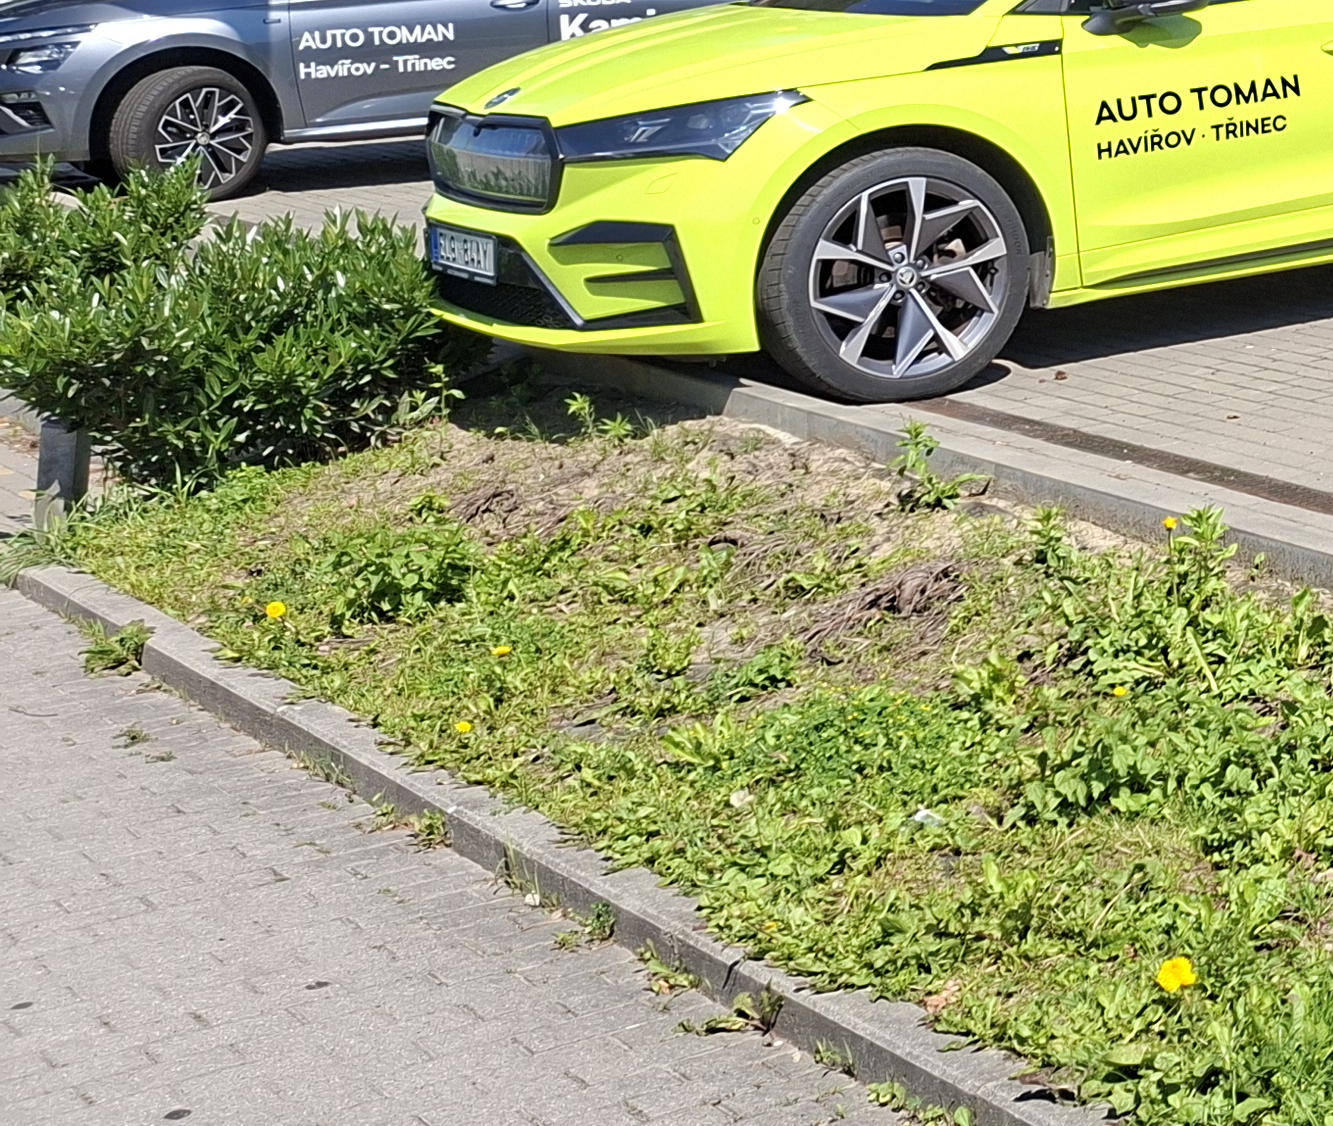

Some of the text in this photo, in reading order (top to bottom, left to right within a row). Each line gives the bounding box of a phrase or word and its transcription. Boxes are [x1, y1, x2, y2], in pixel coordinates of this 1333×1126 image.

[298, 22, 455, 51] AUTO TOMAN
[299, 58, 377, 80] Havířov
[392, 54, 456, 73] Třinec
[1095, 74, 1301, 126] AUTO TOMAN
[1097, 127, 1196, 161] HAVÍŘOV
[1210, 114, 1288, 142] TŘINEC
